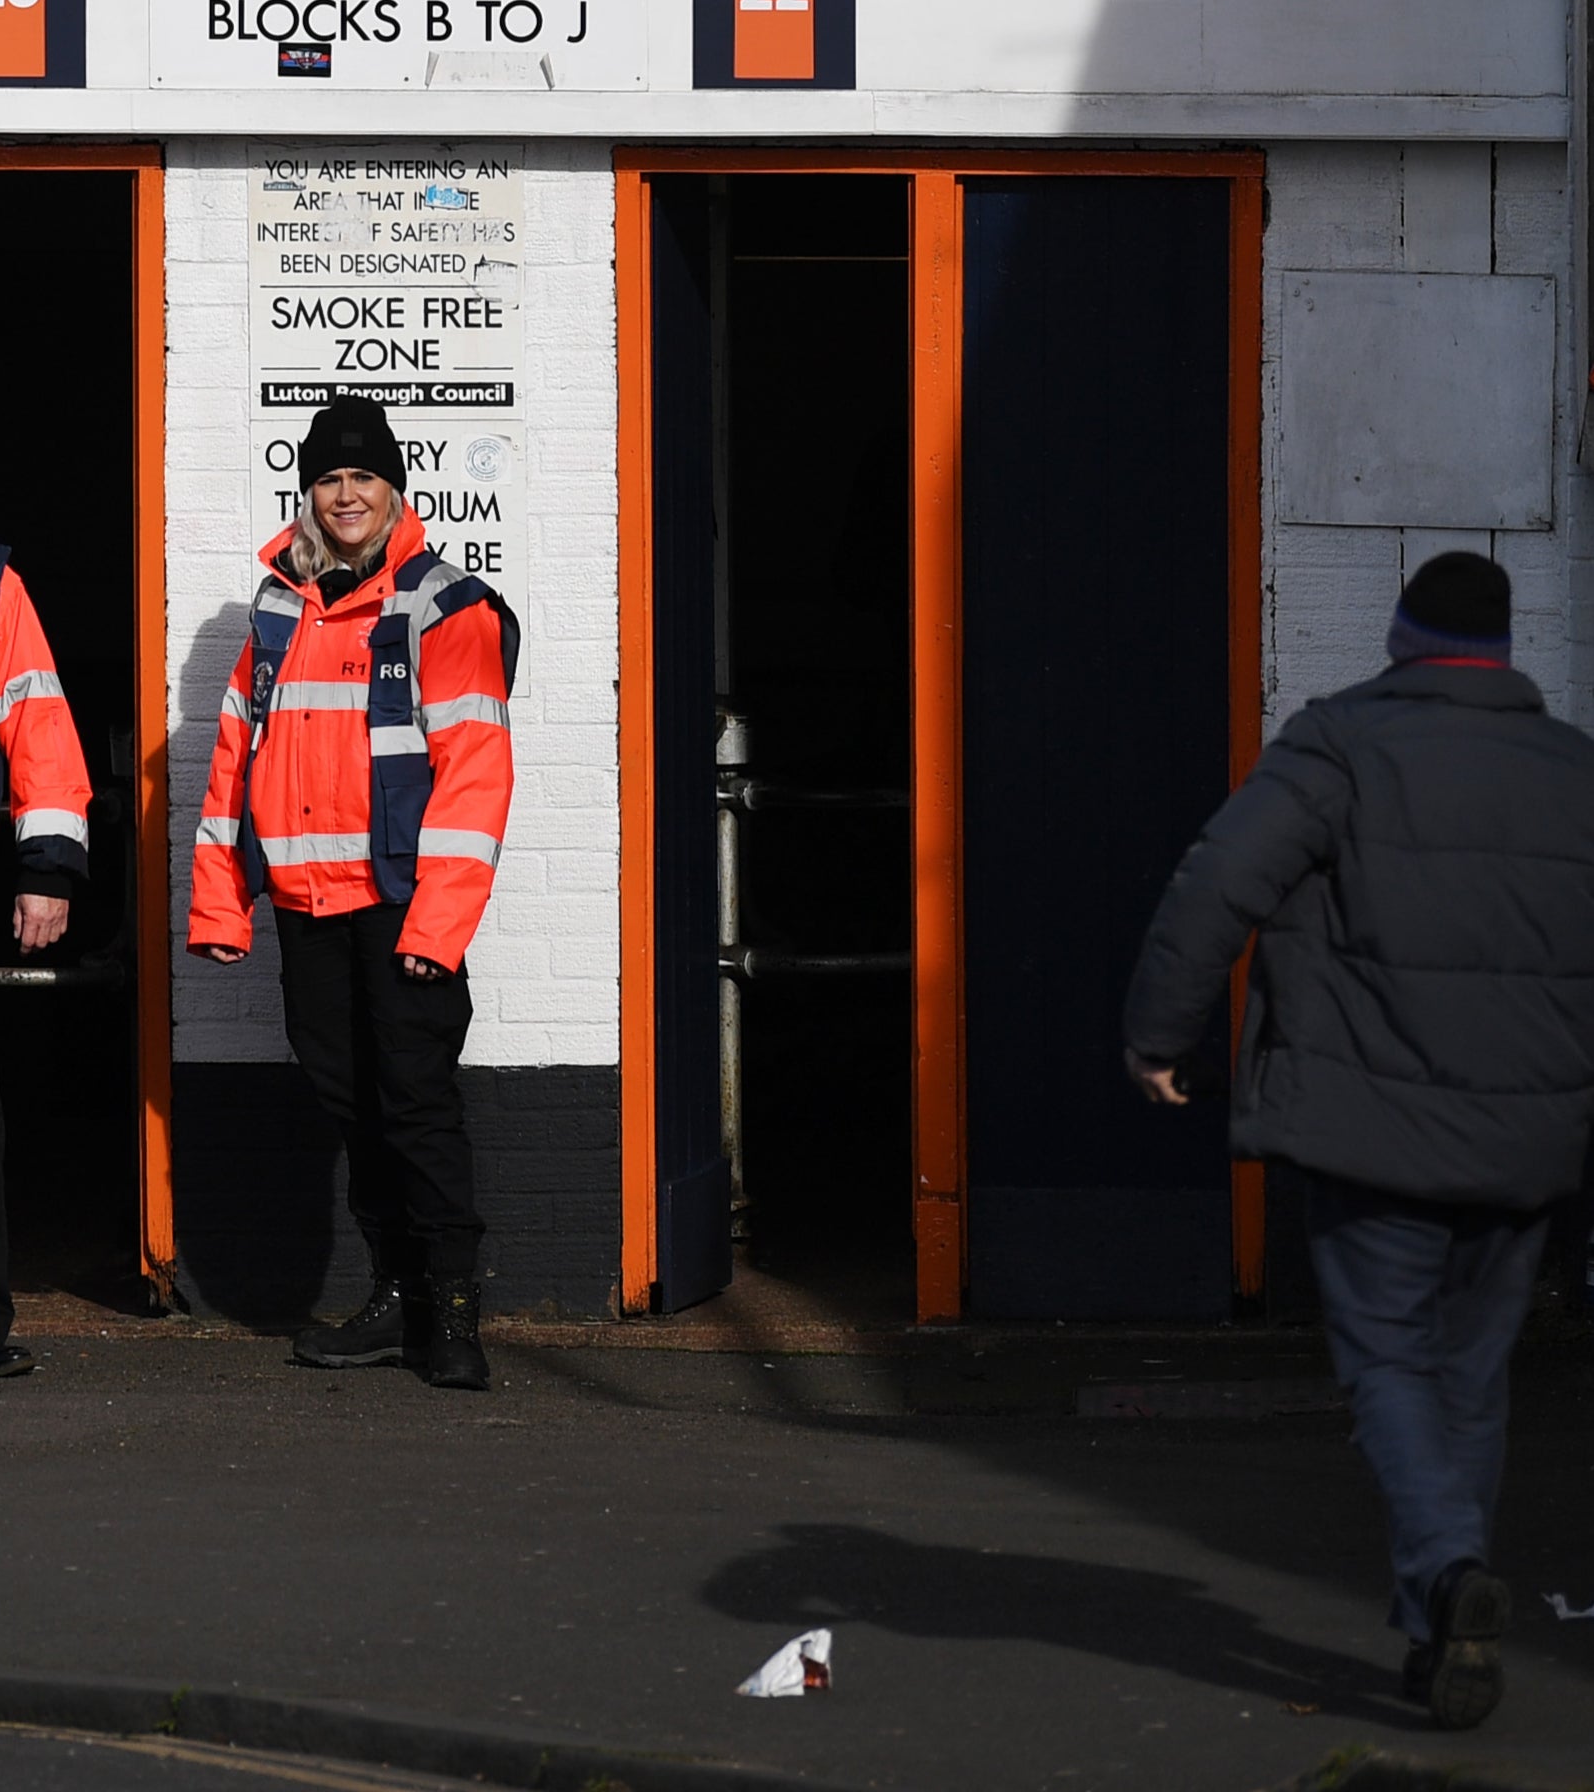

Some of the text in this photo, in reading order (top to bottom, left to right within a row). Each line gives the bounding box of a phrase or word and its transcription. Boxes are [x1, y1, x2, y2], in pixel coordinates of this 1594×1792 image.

[427, 0, 452, 41] B
[476, 0, 542, 43] TO
[567, 1, 586, 43] J
[265, 160, 508, 179] YOU ARE ENTERING AN
[294, 191, 348, 210] AREA
[357, 191, 404, 210] THAT
[281, 255, 330, 273] BEEN
[341, 254, 466, 273] DESIGNATED
[272, 297, 503, 329] SMOKE FREE
[336, 339, 439, 371] ZONE
[268, 384, 328, 402] Luton
[431, 383, 507, 402] Council
[266, 439, 301, 472] O
[465, 542, 501, 572] BE
[379, 663, 406, 679] R6
